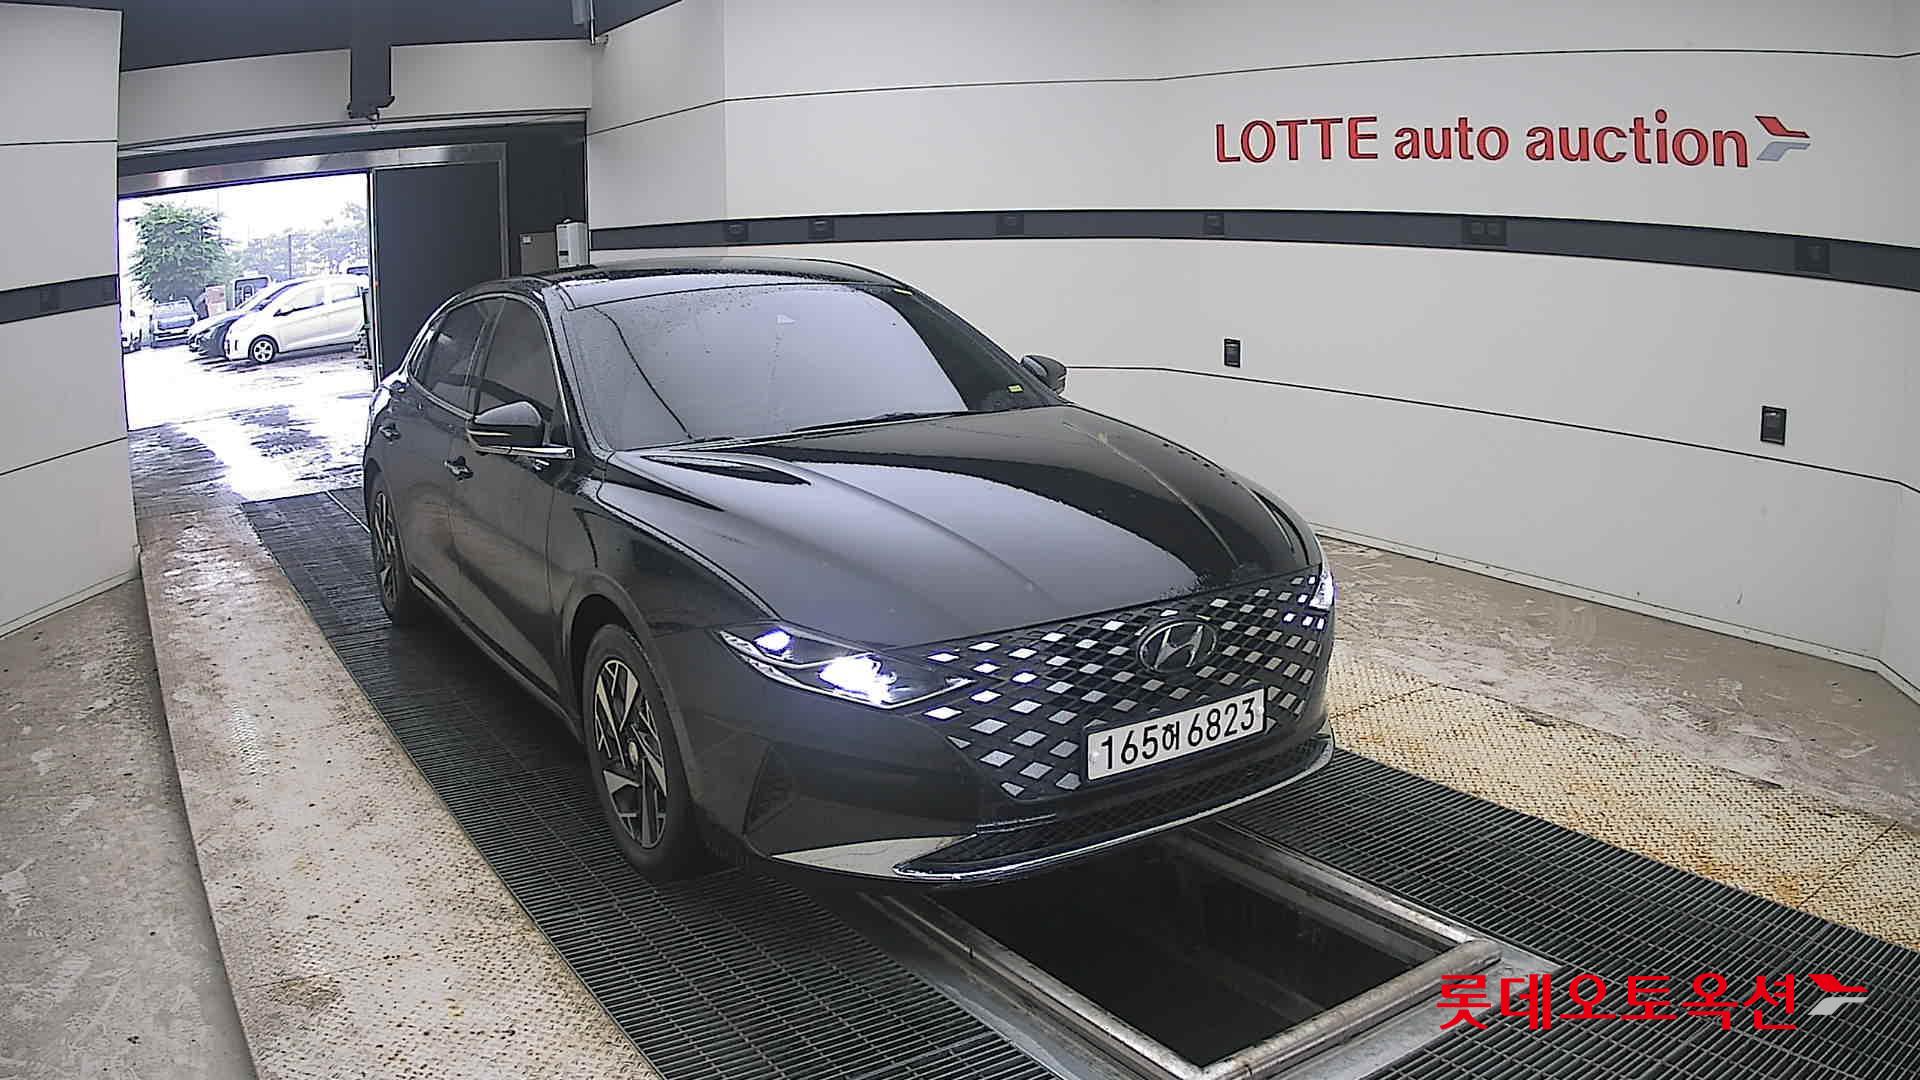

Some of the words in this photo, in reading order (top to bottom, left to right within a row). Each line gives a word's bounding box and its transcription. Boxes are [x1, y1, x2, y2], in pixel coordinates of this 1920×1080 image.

[1215, 115, 1378, 163] LOTTE
[1394, 117, 1509, 162] auto
[1525, 109, 1749, 168] auction
[1187, 696, 1256, 747] 6823
